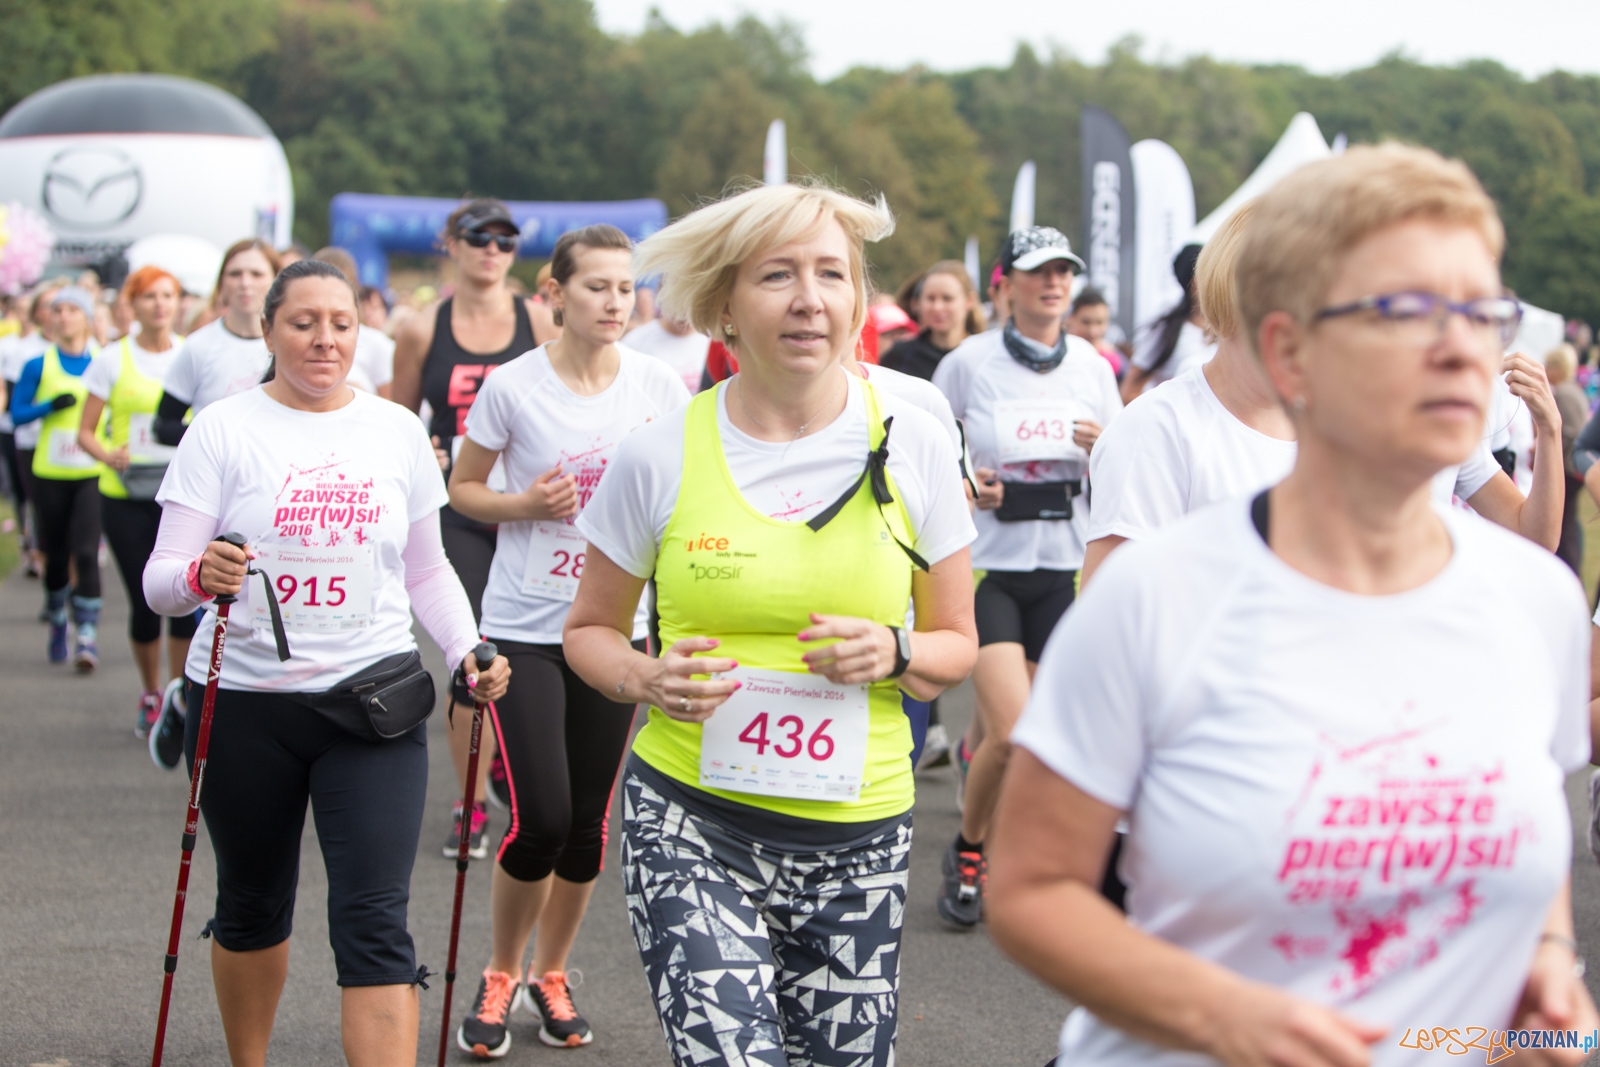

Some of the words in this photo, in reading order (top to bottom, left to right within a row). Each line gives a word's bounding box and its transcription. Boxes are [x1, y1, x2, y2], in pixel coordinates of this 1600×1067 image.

[1017, 420, 1064, 441] 643
[290, 489, 370, 504] zawsze
[279, 524, 313, 537] 2016
[277, 553, 304, 563] Zawsze
[336, 556, 354, 564] 2016
[276, 574, 347, 607] 915
[746, 682, 781, 694] Zawsze
[823, 690, 845, 701] 2016
[738, 712, 835, 761] 436
[1320, 796, 1495, 827] zawsze
